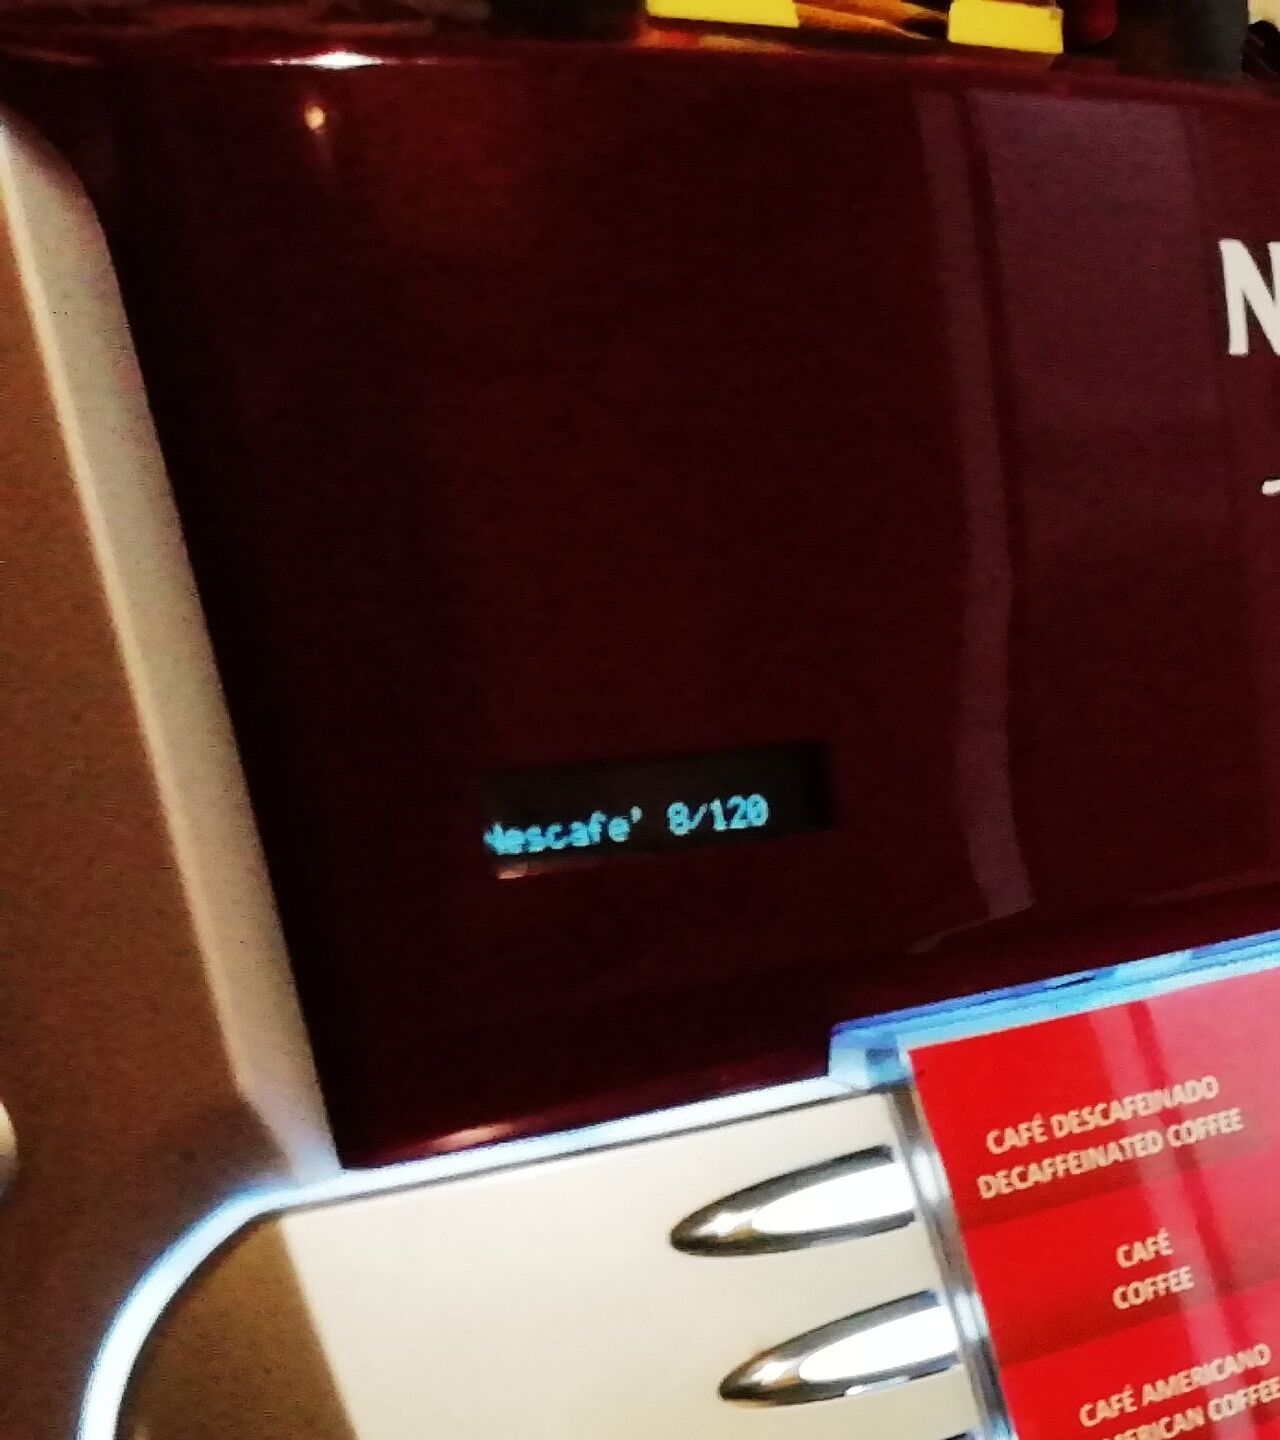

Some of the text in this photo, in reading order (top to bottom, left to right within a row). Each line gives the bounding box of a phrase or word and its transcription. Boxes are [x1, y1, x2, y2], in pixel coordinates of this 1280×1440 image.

[666, 793, 769, 837] 8/120
[986, 1075, 1219, 1154] CAFÉ DESCAFEINADO
[977, 1108, 1244, 1199] DECAFFEINATED COFFEE
[1116, 1227, 1174, 1268] CAFÉ
[1113, 1265, 1195, 1309] COFFEE
[1079, 1343, 1272, 1427] CAFÉ AMERICANO
